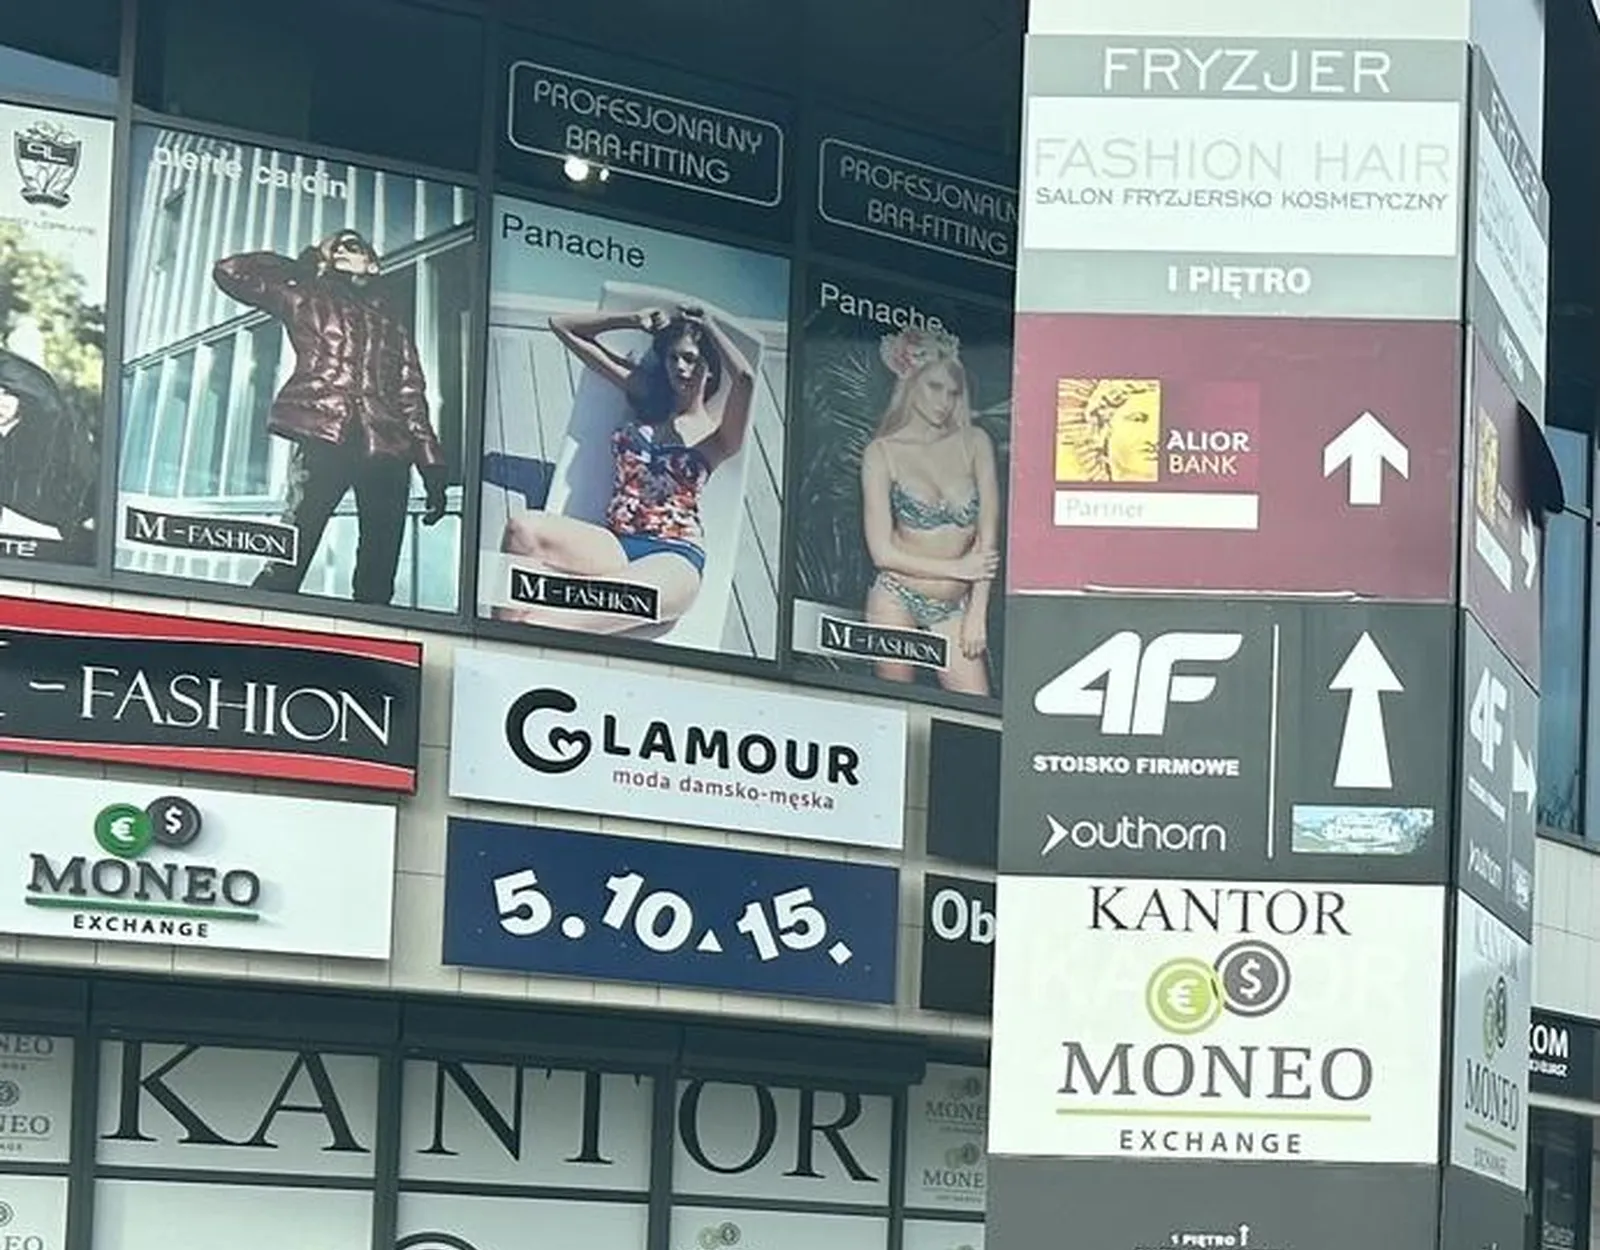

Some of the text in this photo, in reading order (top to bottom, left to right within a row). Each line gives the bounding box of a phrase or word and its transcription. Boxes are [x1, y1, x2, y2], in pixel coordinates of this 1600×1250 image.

[1104, 47, 1391, 94] FRYZJER
[533, 80, 763, 155] PROFESJONALNY
[566, 124, 731, 184] BRA-FITTING
[1035, 138, 1451, 184] FASHION HAIR
[256, 166, 347, 198] cardin
[840, 156, 1018, 223] PROFESJONALN
[1035, 186, 1448, 211] SALON FRYZJERSKO KOSMETYCZNY
[501, 213, 645, 268] Panache
[868, 199, 1008, 256] BRA-FITTING
[1168, 266, 1311, 298] I PIĘTRO
[820, 282, 945, 331] Panache
[1167, 429, 1249, 453] ALIOR
[1169, 455, 1238, 475] BANK
[1065, 498, 1145, 519] Partner
[1034, 631, 1243, 735] 4F
[505, 687, 860, 786] GLAMOUR
[1033, 754, 1240, 776] STOISKO FIRMOWE
[613, 769, 835, 811] moda damsko-męska
[1071, 816, 1226, 853] outhorn
[26, 853, 261, 907] MONEO
[74, 914, 209, 938] EXCHANGE
[1088, 886, 1351, 936] KANTOR
[1056, 1041, 1373, 1101] MONEO
[101, 1036, 879, 1183] KANTOR
[1120, 1130, 1302, 1154] EXCHANGE
[923, 1168, 985, 1188] MONE
